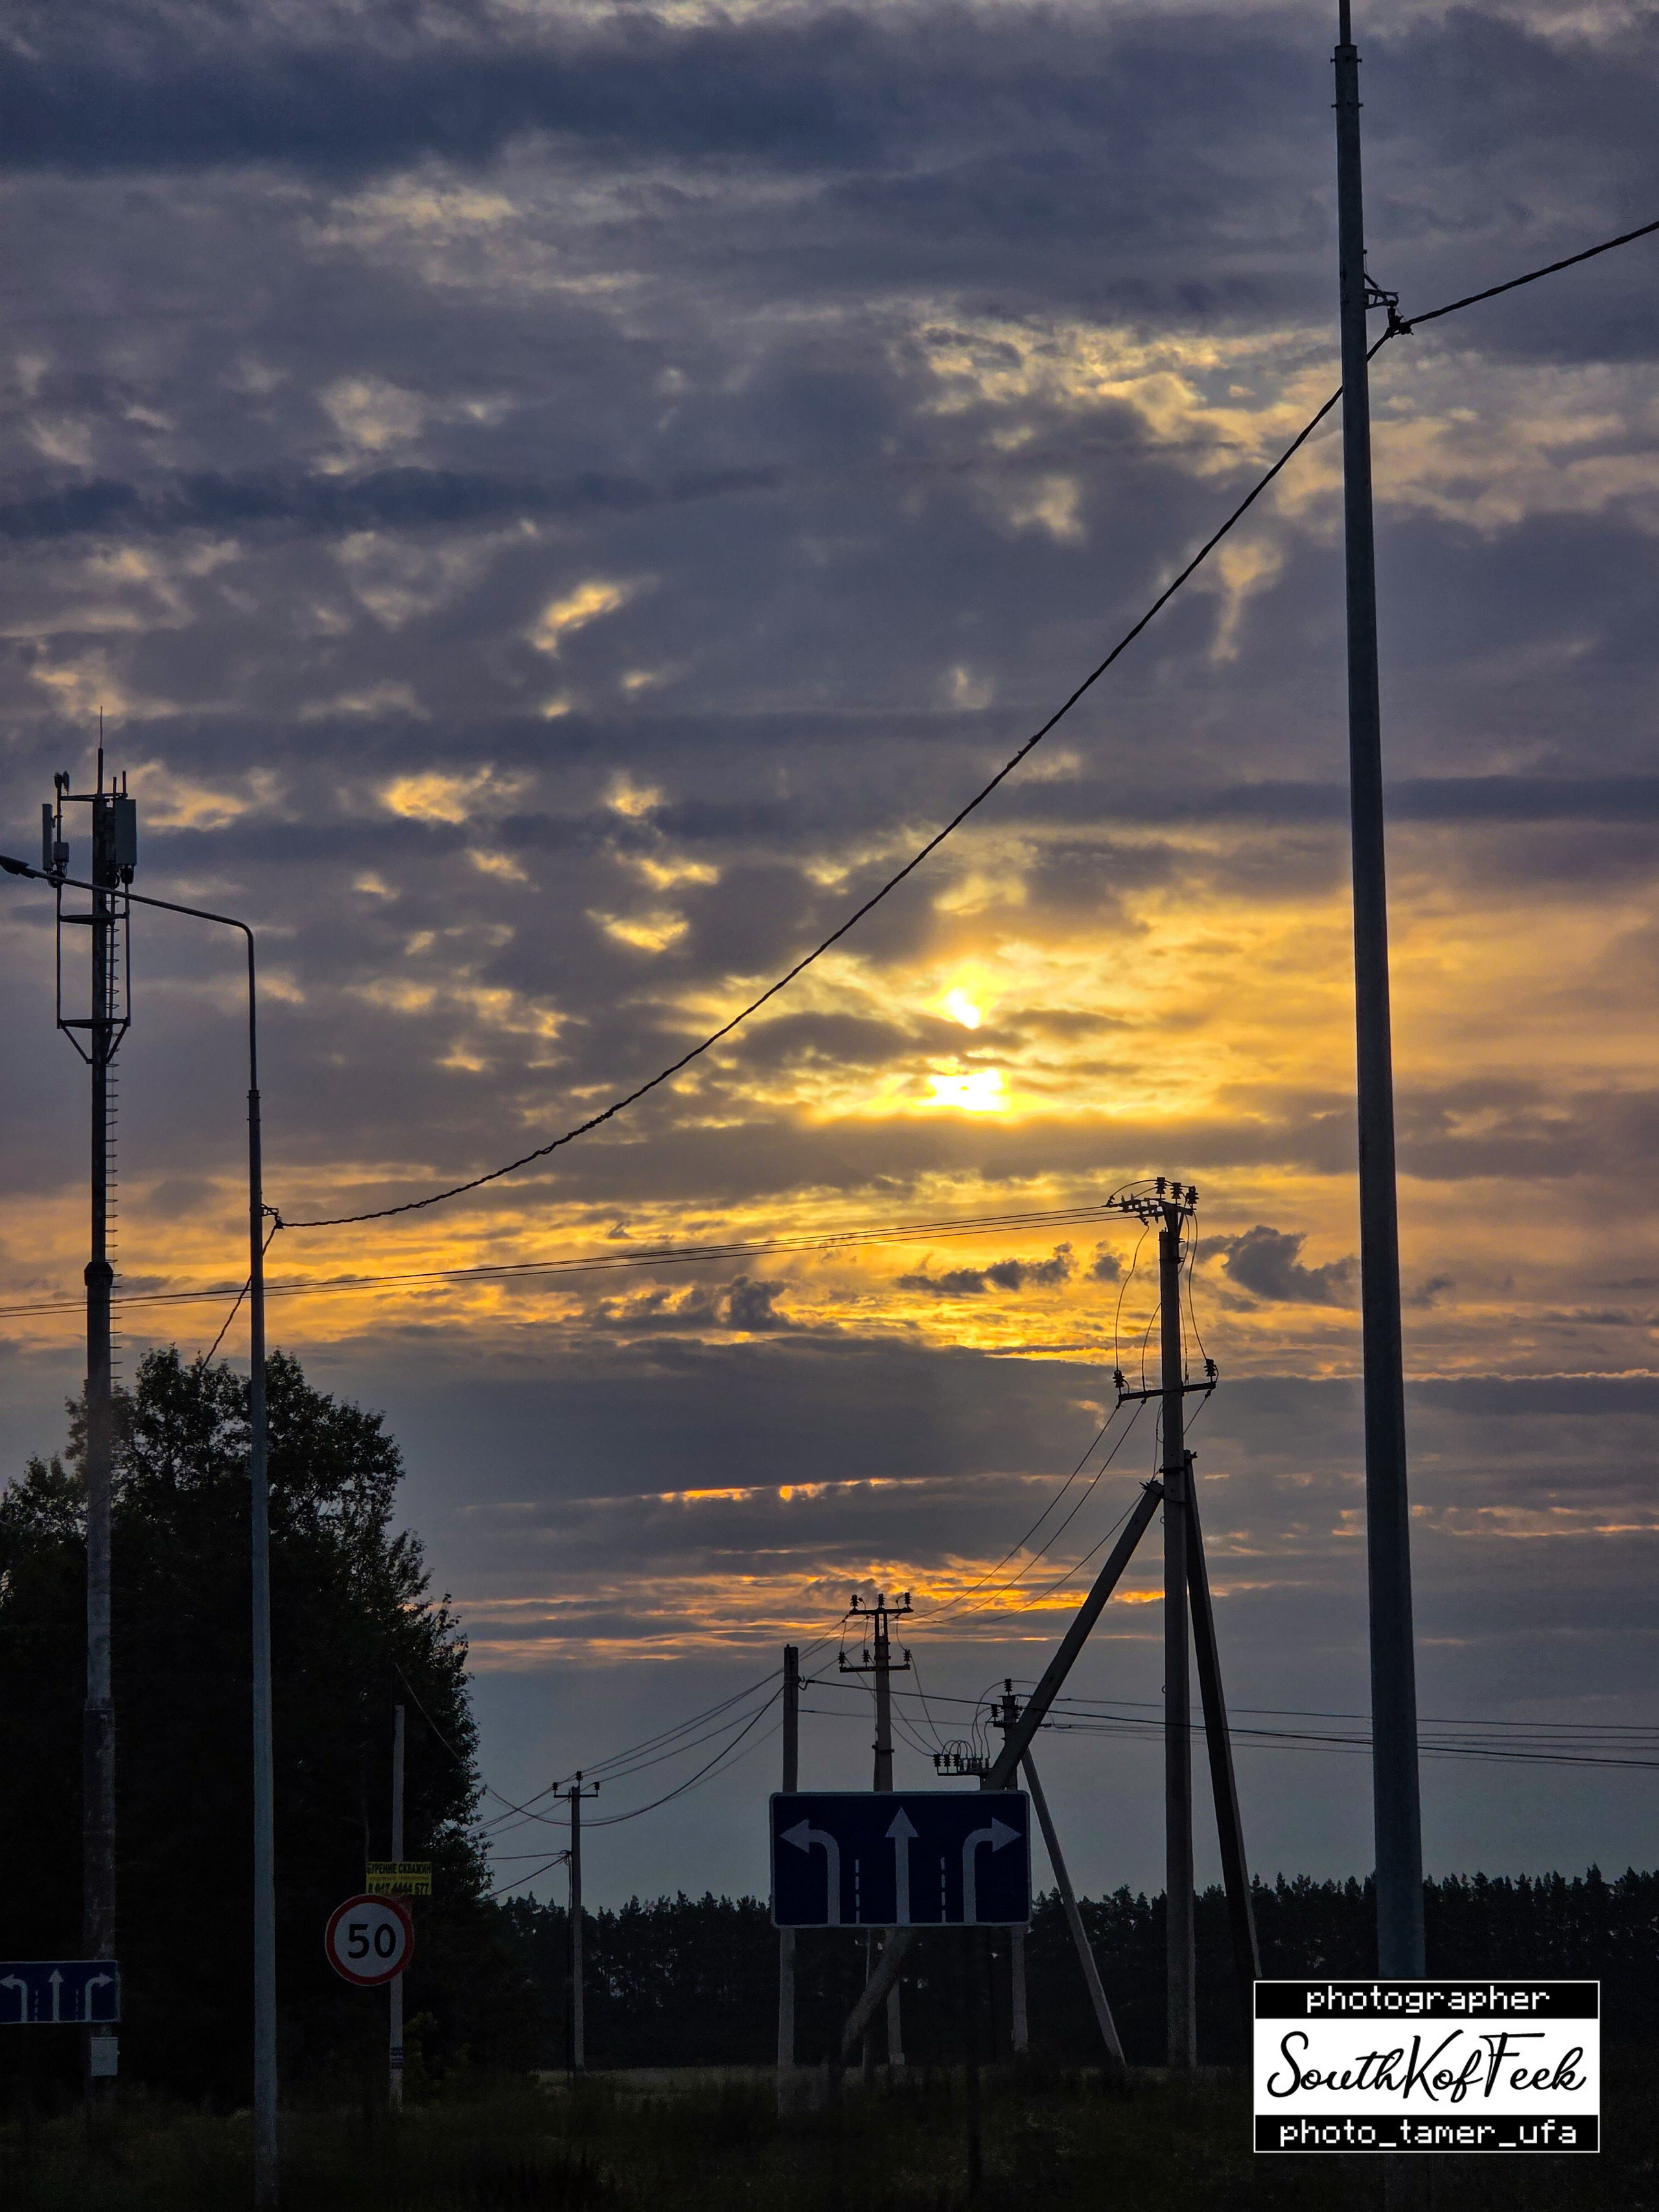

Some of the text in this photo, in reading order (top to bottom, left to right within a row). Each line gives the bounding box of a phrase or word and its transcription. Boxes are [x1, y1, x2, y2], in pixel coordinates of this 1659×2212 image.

[367, 1863, 432, 1874] БУРЕНИЕ СКВАЖИН
[348, 1924, 396, 1959] 50
